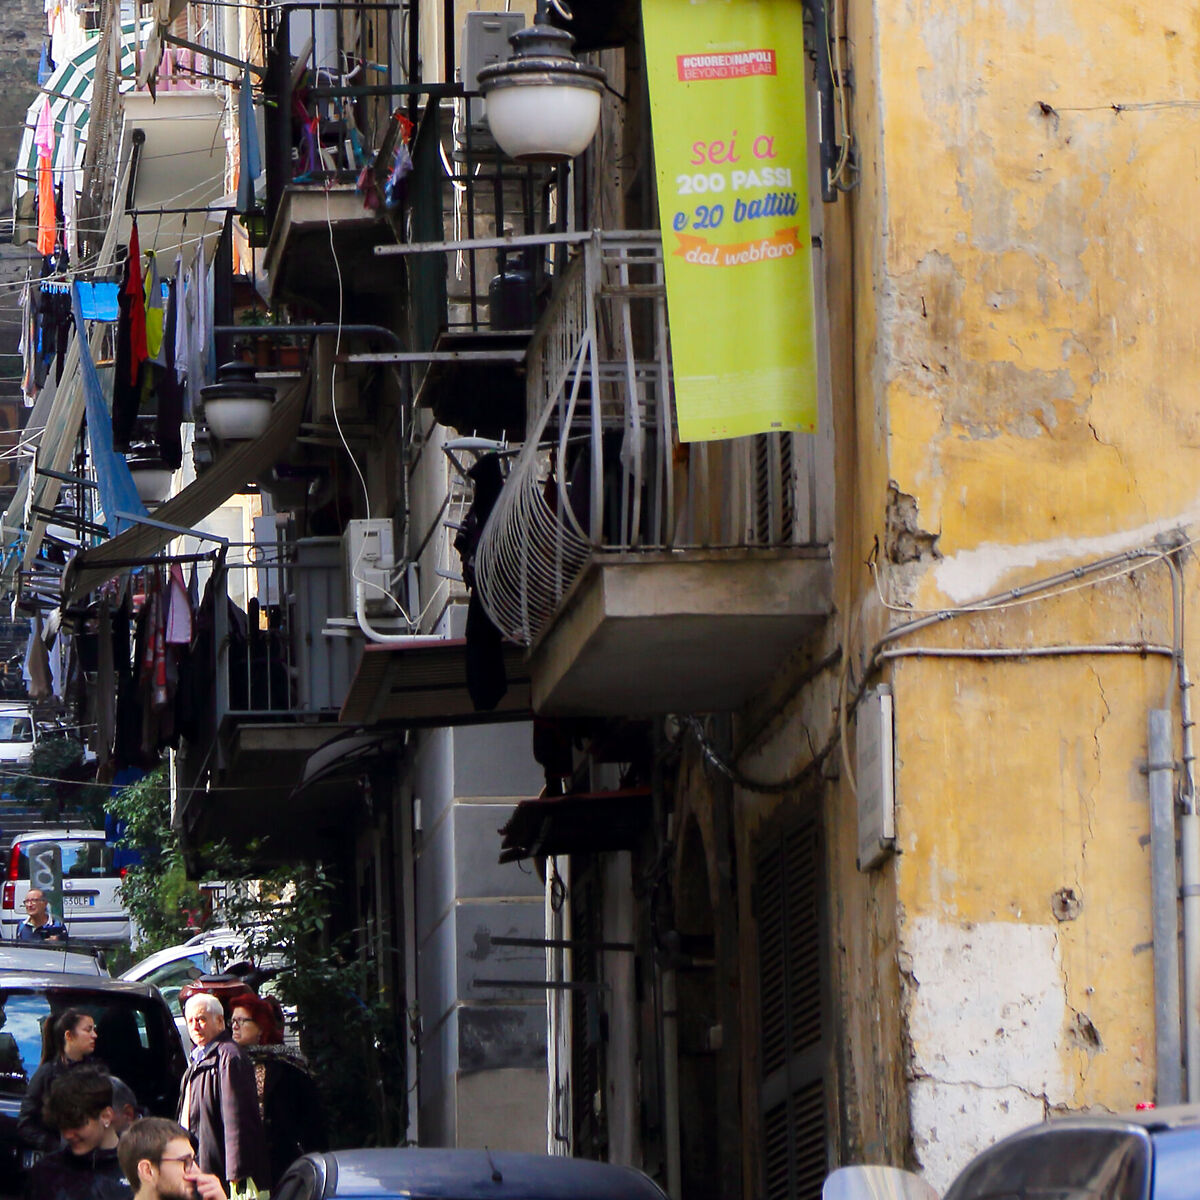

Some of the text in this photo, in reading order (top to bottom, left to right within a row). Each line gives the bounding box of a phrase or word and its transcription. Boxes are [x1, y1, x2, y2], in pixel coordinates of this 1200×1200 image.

[683, 51, 772, 68] #CUOREDINAPOLI
[684, 63, 772, 79] BEYOND THE LAB
[690, 129, 779, 165] sei a
[676, 167, 792, 195] 200 PASSI
[673, 192, 800, 231] e 20 battiti
[685, 240, 795, 266] dal webfaro
